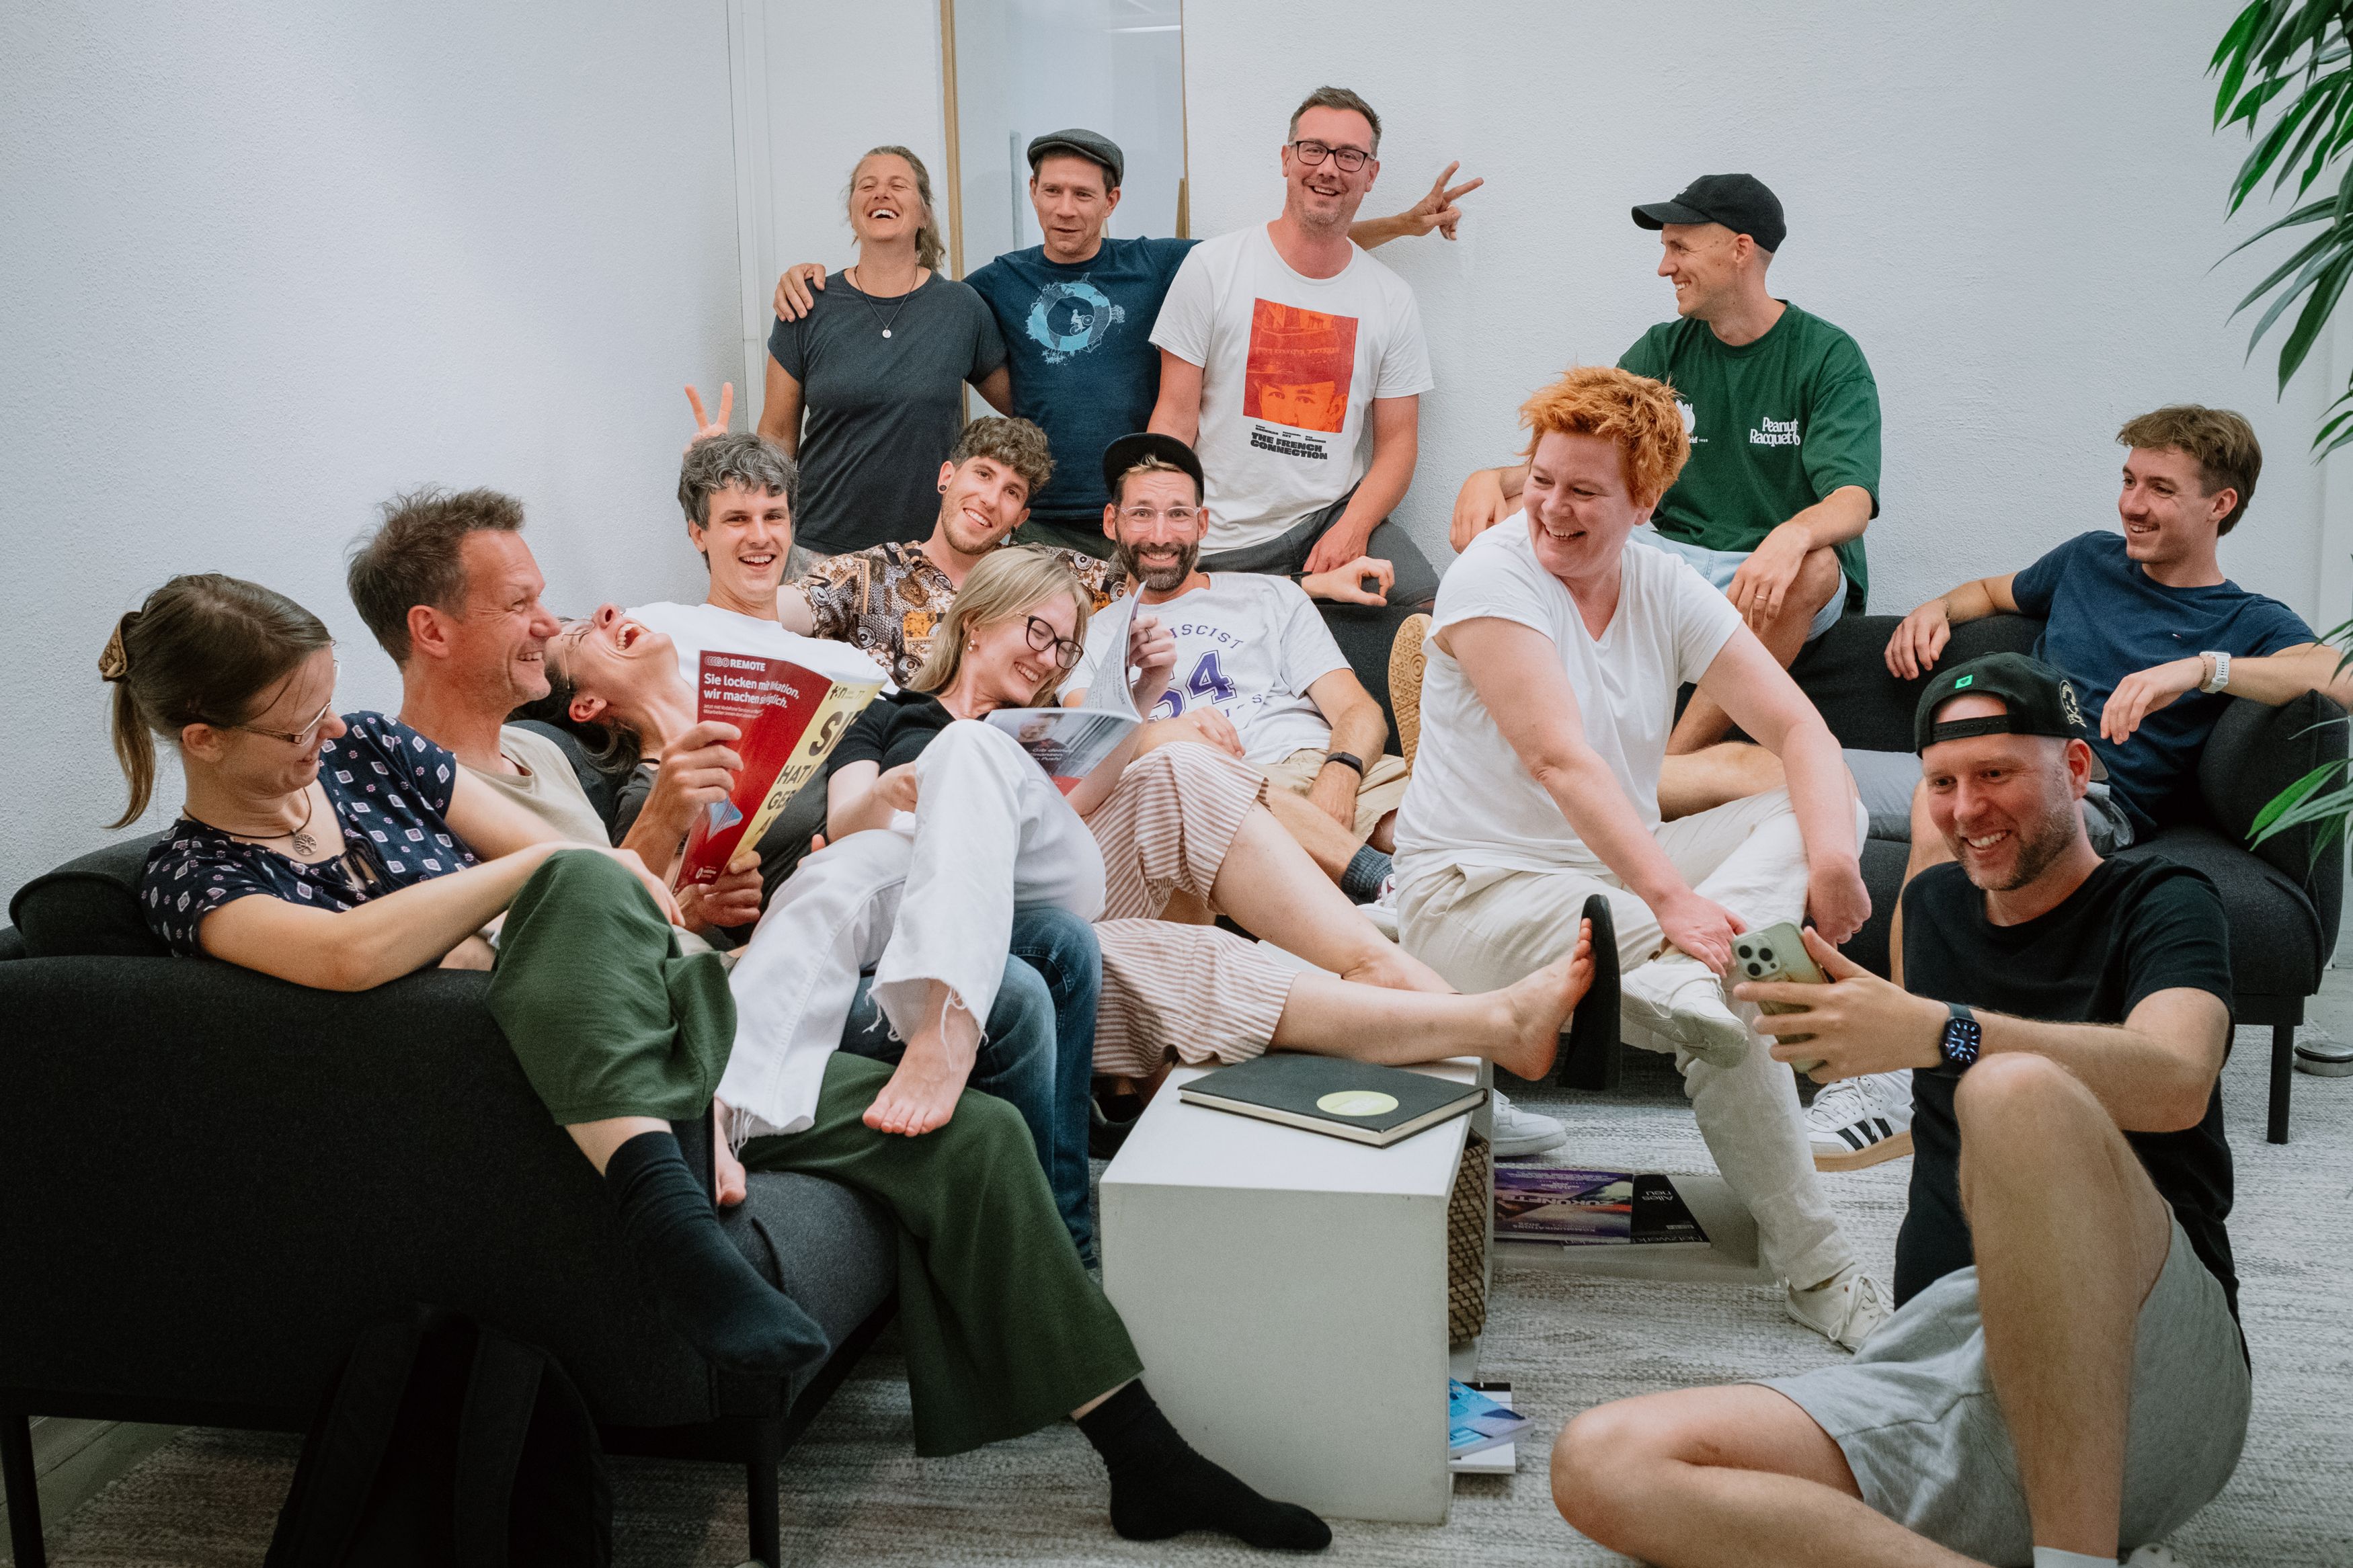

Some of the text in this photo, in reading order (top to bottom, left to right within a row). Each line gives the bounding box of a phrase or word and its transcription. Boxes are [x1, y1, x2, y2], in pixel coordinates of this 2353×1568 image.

[1761, 416, 1799, 433] Peanut
[1251, 431, 1274, 444] THE
[1276, 438, 1322, 452] FRENCH
[1749, 428, 1793, 448] Racquet
[1250, 439, 1328, 460] CONNECTION
[730, 659, 766, 671] REMOTE
[704, 673, 721, 686] Sie
[723, 675, 757, 690] locken
[758, 680, 770, 691] mit
[703, 689, 721, 699] wir
[723, 691, 760, 704] machen
